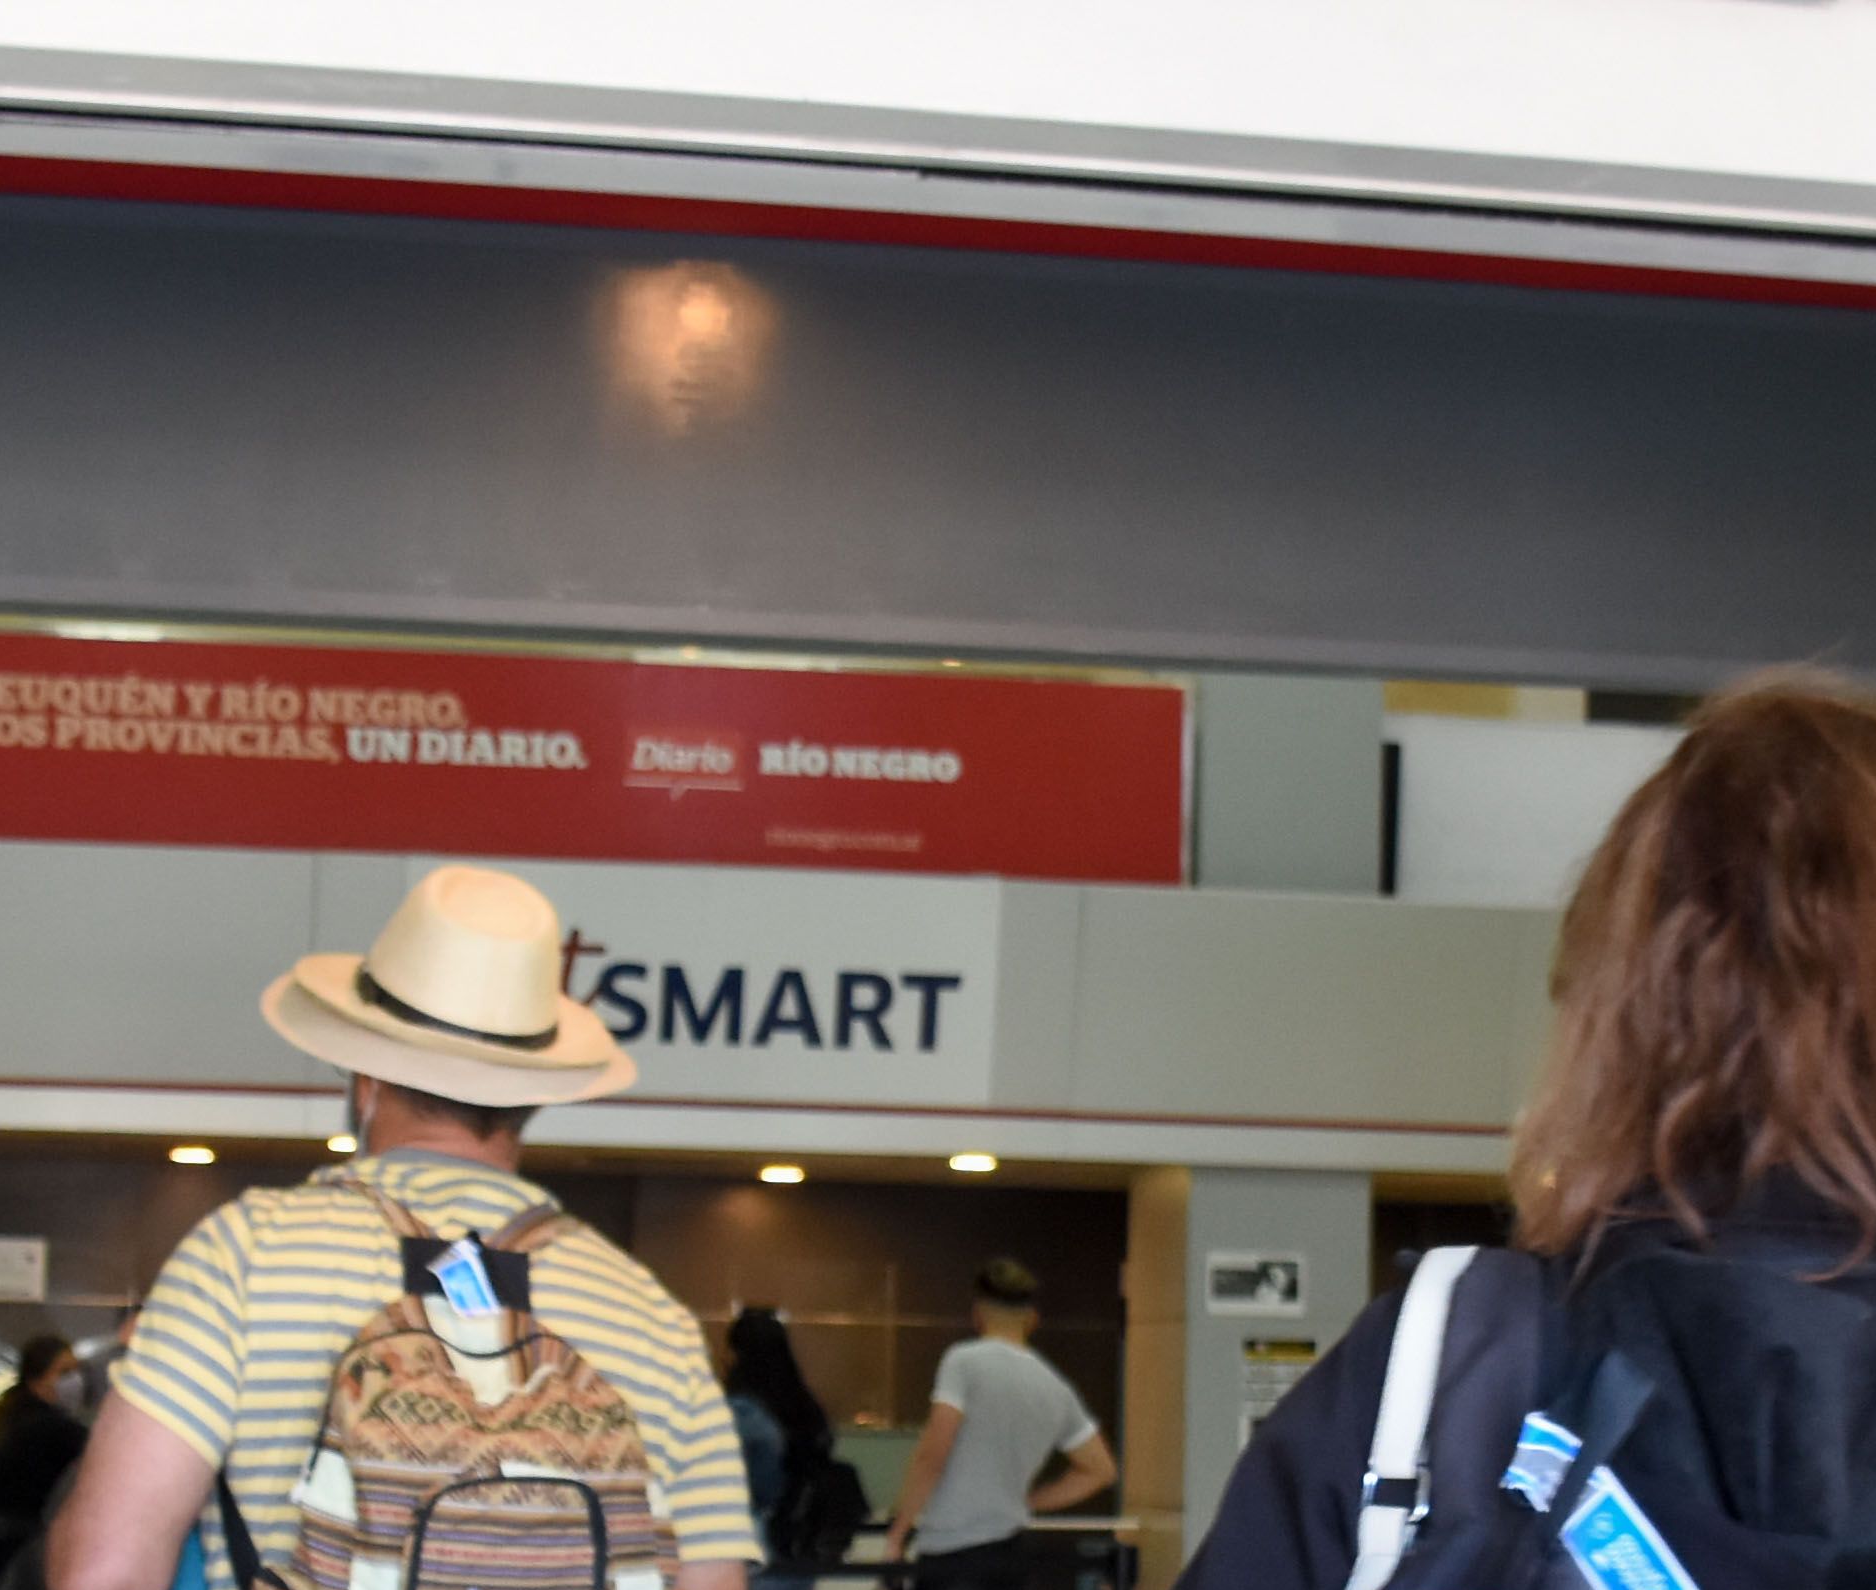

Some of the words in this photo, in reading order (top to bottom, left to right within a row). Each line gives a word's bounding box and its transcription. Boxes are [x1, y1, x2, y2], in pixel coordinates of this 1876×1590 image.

[180, 683, 213, 718] Y
[220, 678, 302, 722] RÍO
[53, 716, 342, 763] PROVINCIAS,
[346, 726, 411, 763] UN
[415, 727, 589, 770] DIARIO.
[631, 738, 736, 775] Diario
[758, 738, 827, 778] RÍO
[829, 746, 963, 784] NEGRO
